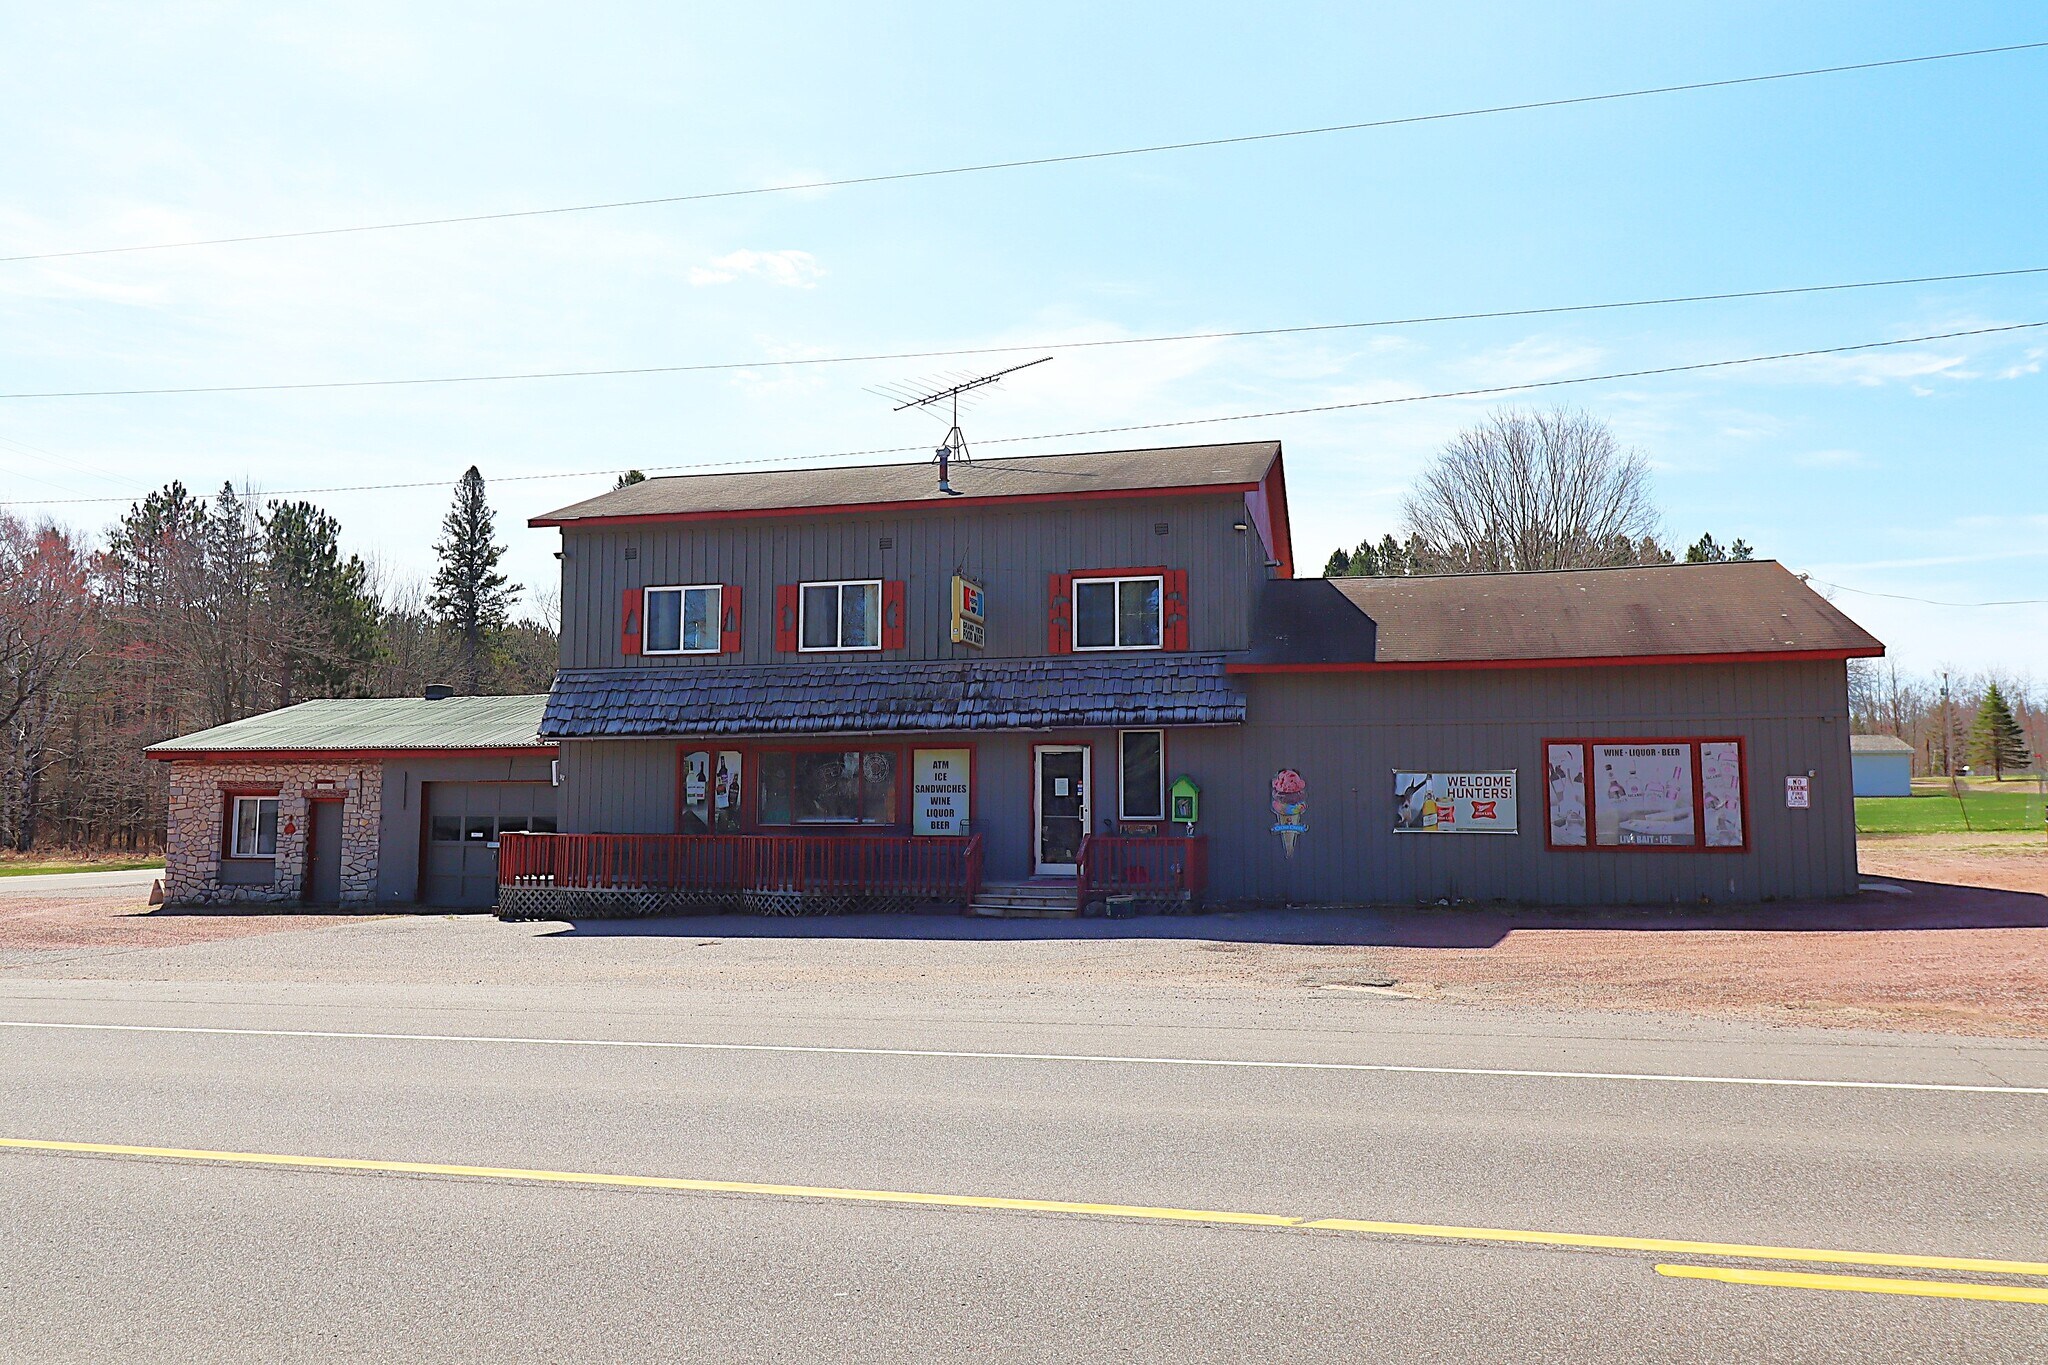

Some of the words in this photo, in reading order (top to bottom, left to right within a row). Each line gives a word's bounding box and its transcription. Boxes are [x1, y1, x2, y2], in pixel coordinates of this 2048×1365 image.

[1604, 749, 1623, 757] WINE
[1629, 748, 1656, 757] LIQUOR
[1662, 748, 1680, 756] BEER
[933, 761, 949, 769] ATM
[934, 773, 947, 781] ICE
[1447, 776, 1511, 787] WELCOME
[915, 784, 967, 793] SANDWICHES
[1447, 788, 1512, 799] HUNTERS!
[930, 797, 951, 805] WINE
[926, 809, 955, 817] LIQUOR
[930, 821, 950, 829] BEER
[1636, 835, 1654, 843] BAIT
[1660, 835, 1672, 844] ICE
